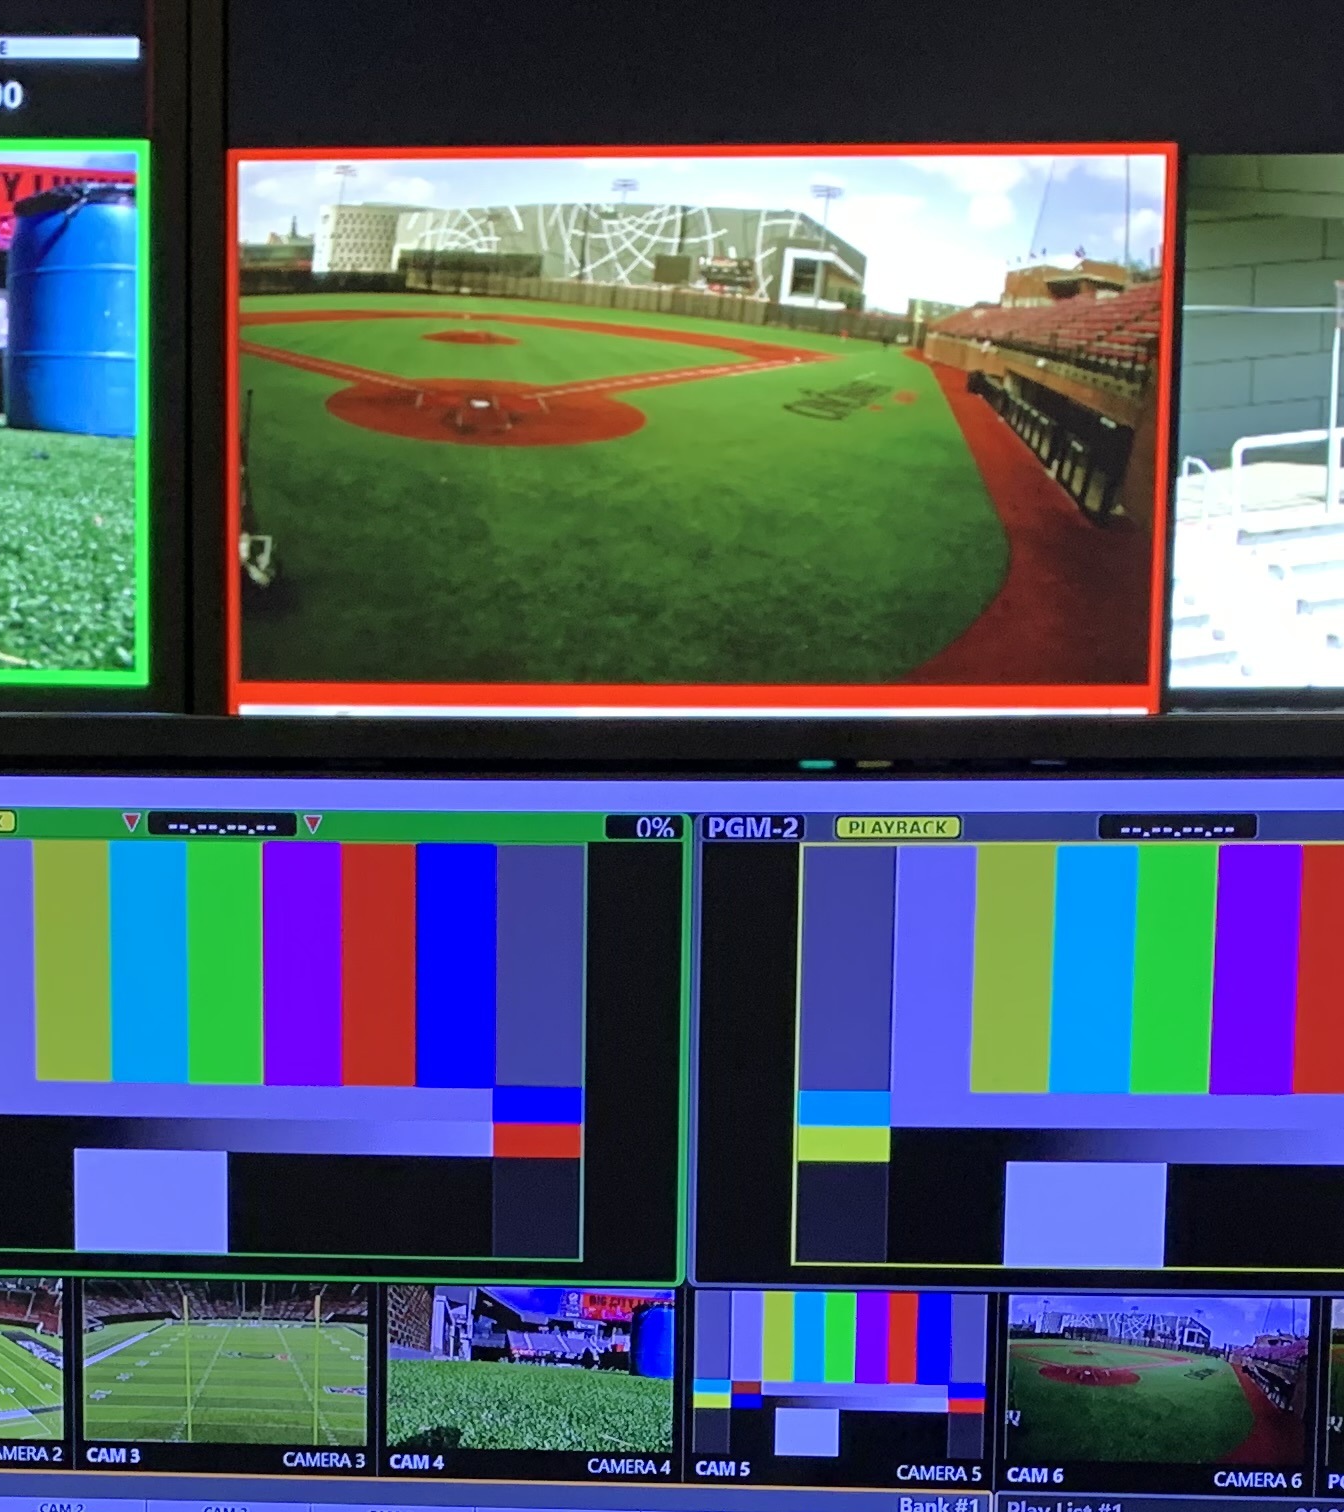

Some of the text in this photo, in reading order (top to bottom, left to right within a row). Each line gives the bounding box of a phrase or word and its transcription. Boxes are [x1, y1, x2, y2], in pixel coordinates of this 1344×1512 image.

[636, 817, 675, 838] 0%
[708, 818, 799, 839] PGM-2
[849, 820, 947, 835] PLAYBACK
[51, 1446, 63, 1461] 2
[87, 1447, 141, 1463] CAM 3
[283, 1452, 366, 1469] CAMERA 3
[390, 1454, 445, 1470] CAM 4
[588, 1458, 671, 1475] CAMERA 4
[695, 1461, 750, 1477] CAM 5
[897, 1465, 982, 1482] CAMERA 5
